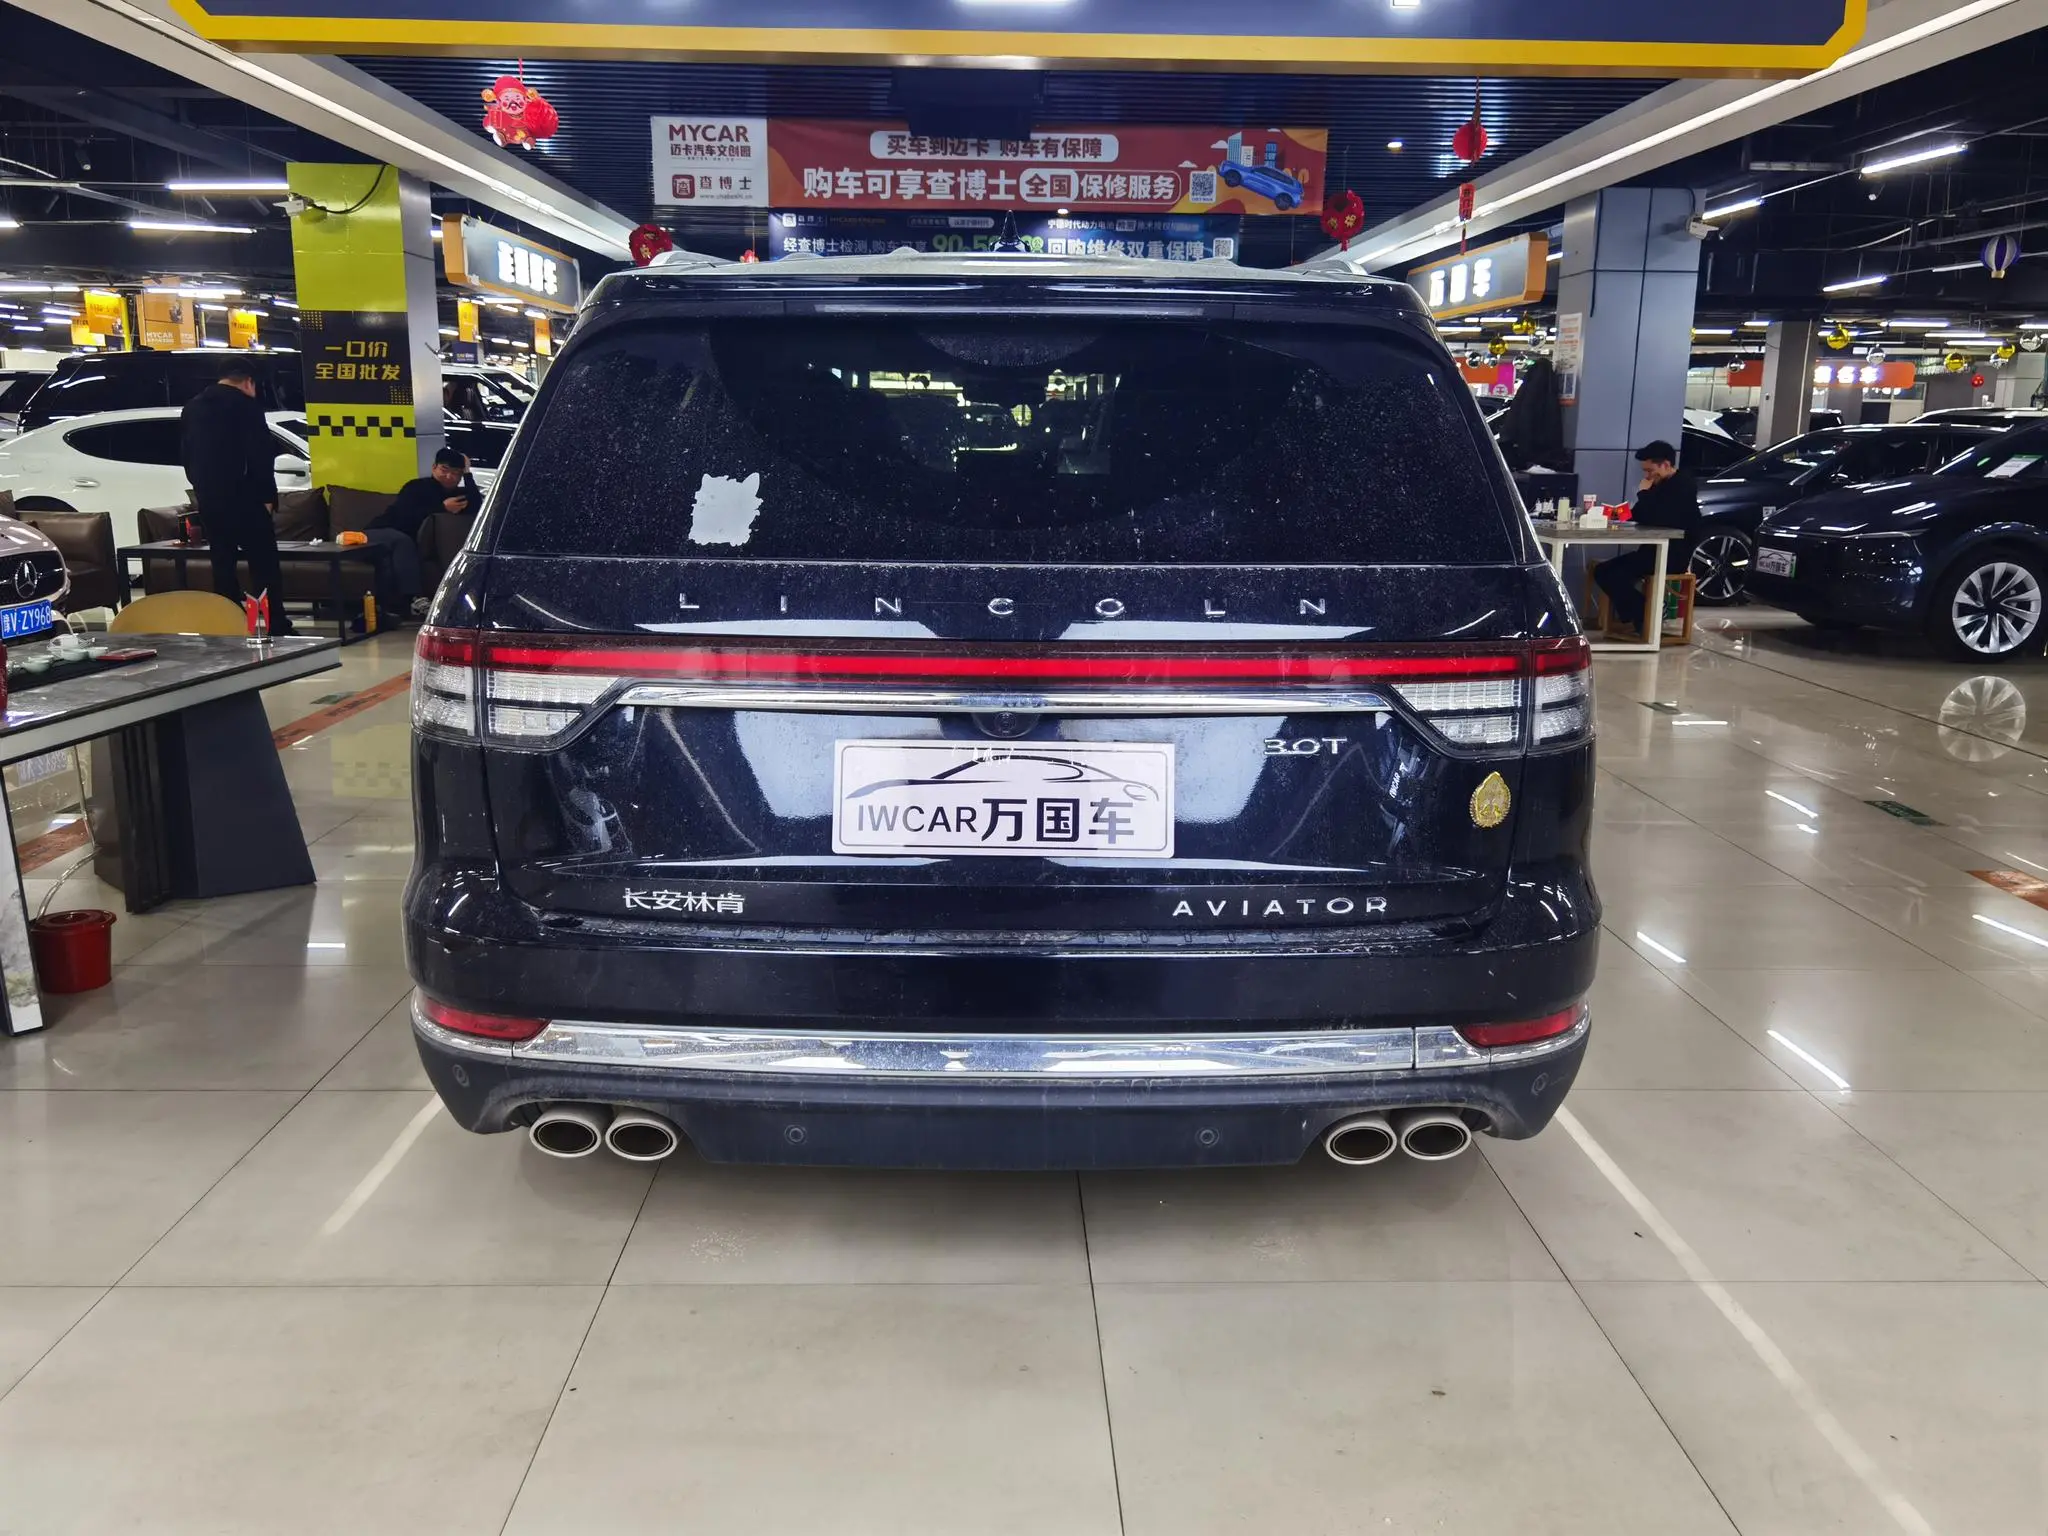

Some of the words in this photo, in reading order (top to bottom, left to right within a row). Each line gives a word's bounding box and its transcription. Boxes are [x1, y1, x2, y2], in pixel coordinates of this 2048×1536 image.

[669, 124, 750, 142] MYCAR
[887, 134, 989, 157] 买车到迈卡
[1000, 137, 1102, 159] 购车有保障
[700, 175, 752, 190] 查博士
[325, 341, 388, 358] 一口价
[314, 363, 401, 380] 全国批发
[680, 592, 1326, 617] LINCOLN
[622, 887, 745, 914] 长安林肯
[1172, 897, 1388, 917] AVIATOR
